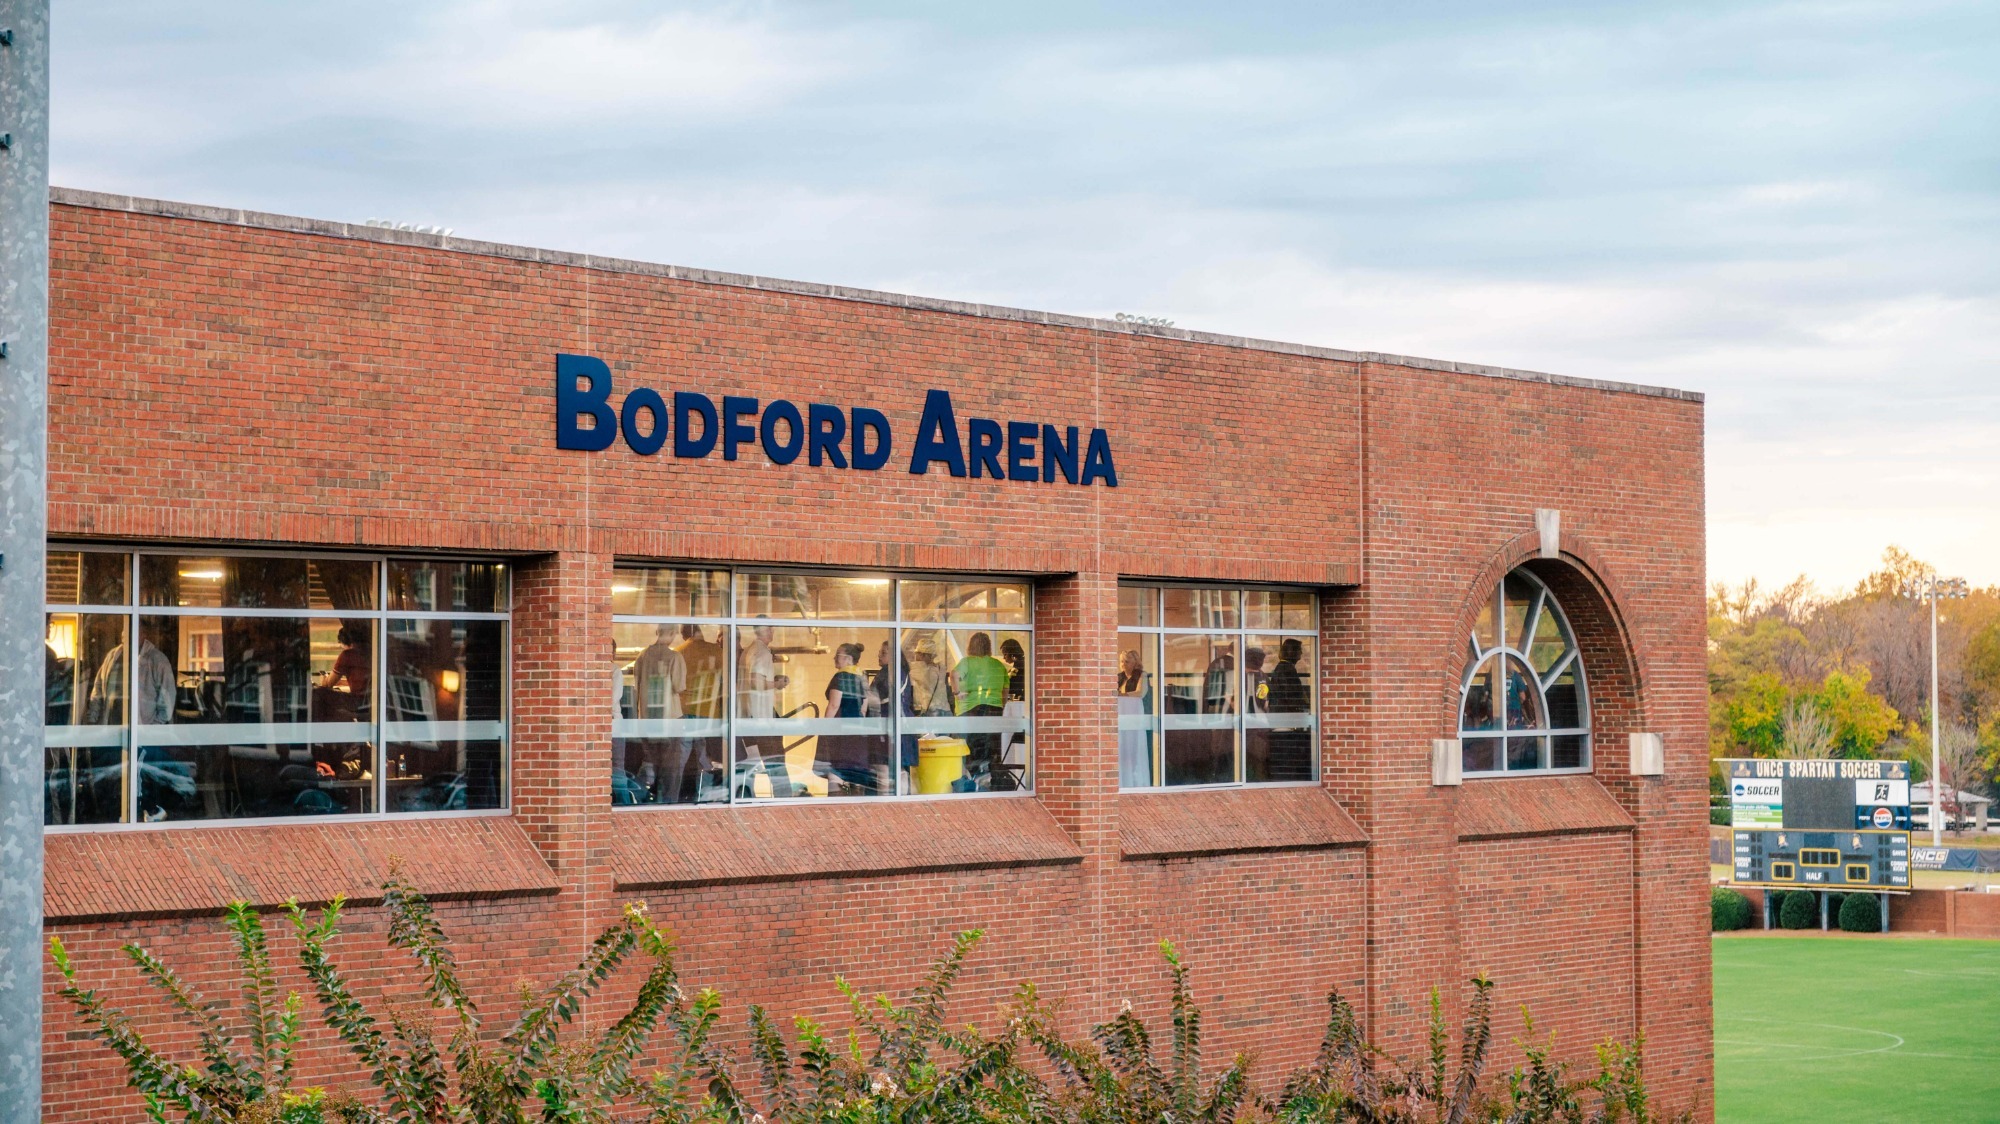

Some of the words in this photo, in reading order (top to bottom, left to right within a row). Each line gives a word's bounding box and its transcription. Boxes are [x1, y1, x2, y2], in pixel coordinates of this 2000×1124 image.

[556, 353, 892, 471] BODFORD
[909, 389, 1118, 487] ARENA
[1756, 762, 1784, 778] UNCG
[1789, 762, 1836, 779] SPARTAN
[1840, 763, 1881, 779] SOCCER
[1747, 786, 1780, 796] SOCCER
[1892, 849, 1907, 857] SAVES
[1736, 871, 1750, 879] FOULS
[1806, 871, 1822, 881] HALF
